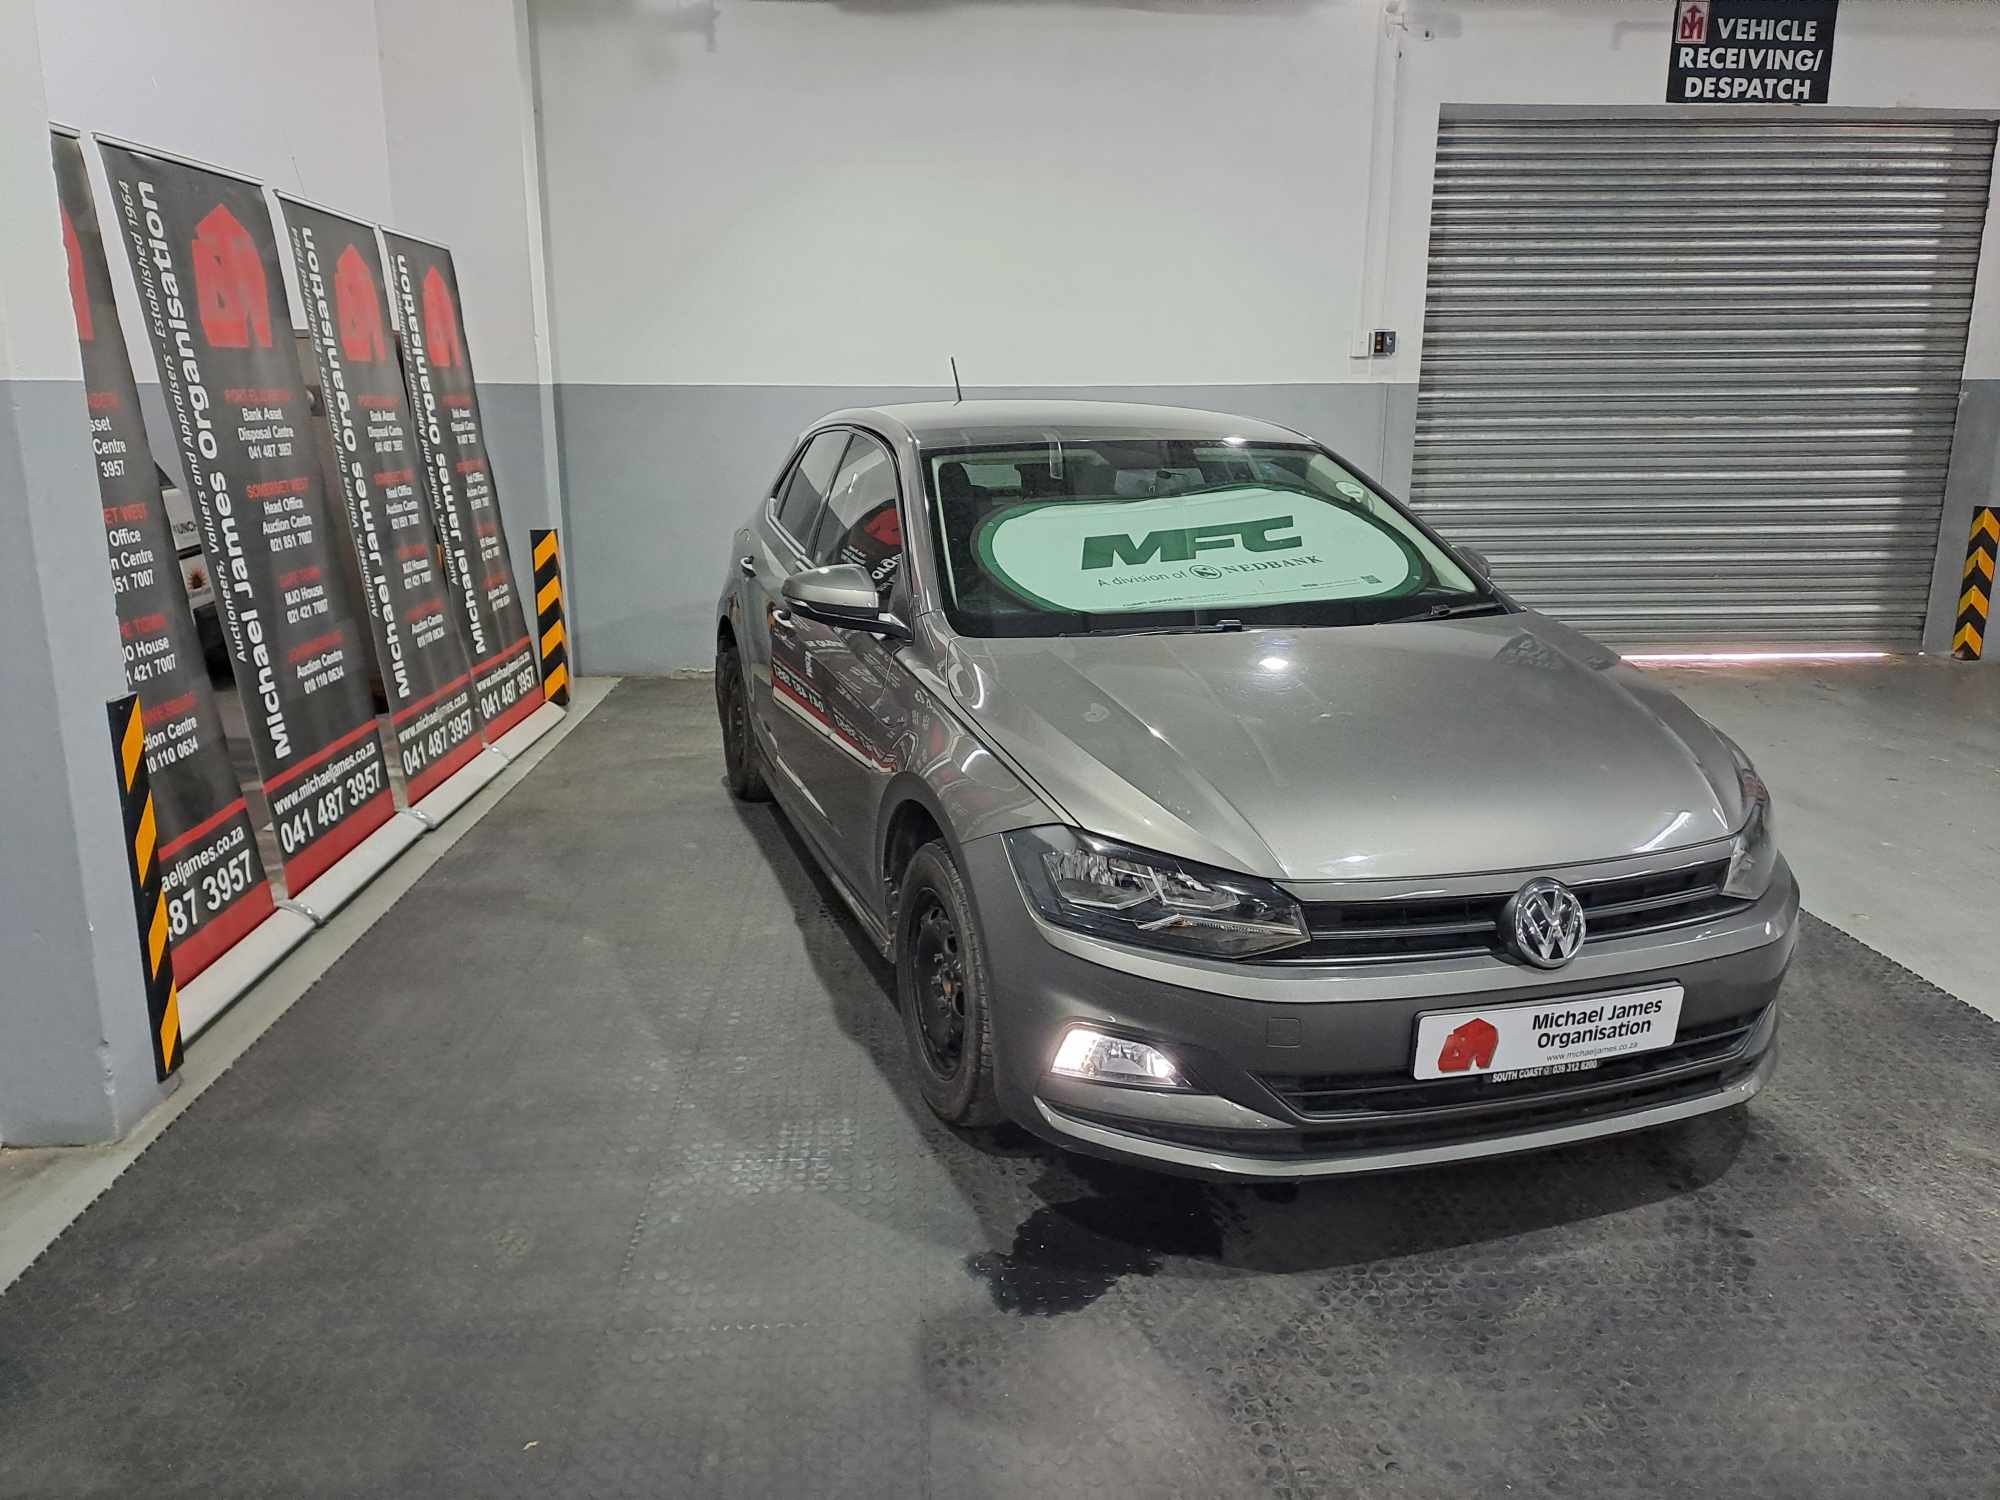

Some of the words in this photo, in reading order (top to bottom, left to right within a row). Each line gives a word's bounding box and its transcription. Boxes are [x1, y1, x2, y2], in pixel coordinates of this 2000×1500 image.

[1717, 17, 1818, 42] VEHICLE
[1678, 47, 1823, 72] RECEIVING/
[1684, 76, 1812, 100] DESPATCH
[118, 180, 138, 229] 1964
[137, 231, 166, 338] Established
[138, 181, 217, 459] Organisation
[301, 226, 356, 452] Organisation
[397, 254, 441, 445] Organisation
[164, 354, 192, 448] Appraisers
[92, 438, 127, 455] Centre
[101, 460, 125, 477] 3957
[186, 450, 201, 486] and
[198, 491, 219, 554] Valuers
[351, 462, 383, 566] James
[436, 453, 462, 542] James
[109, 528, 141, 547] Office
[120, 549, 154, 568] Centre
[210, 471, 253, 599] James
[1081, 515, 1302, 570] MFC
[131, 569, 154, 589] 7007
[1111, 572, 1170, 587] division
[1172, 569, 1189, 580] of
[1222, 555, 1324, 575] NEDBANK
[216, 560, 247, 663] Auctioneers,
[454, 549, 487, 654] Michael
[135, 637, 169, 658] House
[374, 575, 410, 699] Michael
[134, 662, 153, 682] 421
[154, 653, 176, 675] 7007
[240, 609, 292, 760] Michael
[481, 690, 501, 719] 041
[501, 678, 515, 704] 487
[516, 665, 535, 694] 3957
[157, 747, 176, 768] 110
[177, 735, 198, 757] 0634
[167, 716, 197, 739] Centre
[403, 741, 428, 776] 041
[428, 723, 447, 758] 487
[447, 708, 473, 743] 3957
[274, 741, 376, 815] www.michaeljames.co.za
[280, 808, 315, 854] 041
[317, 786, 345, 827] 487
[347, 760, 380, 806] 3957
[168, 887, 199, 942] 87
[202, 848, 253, 911] 3957
[1531, 1007, 1603, 1031] Michael
[1607, 1000, 1662, 1022] James
[1537, 1020, 1651, 1049] Organisation
[1492, 1072, 1518, 1083] SOUTH
